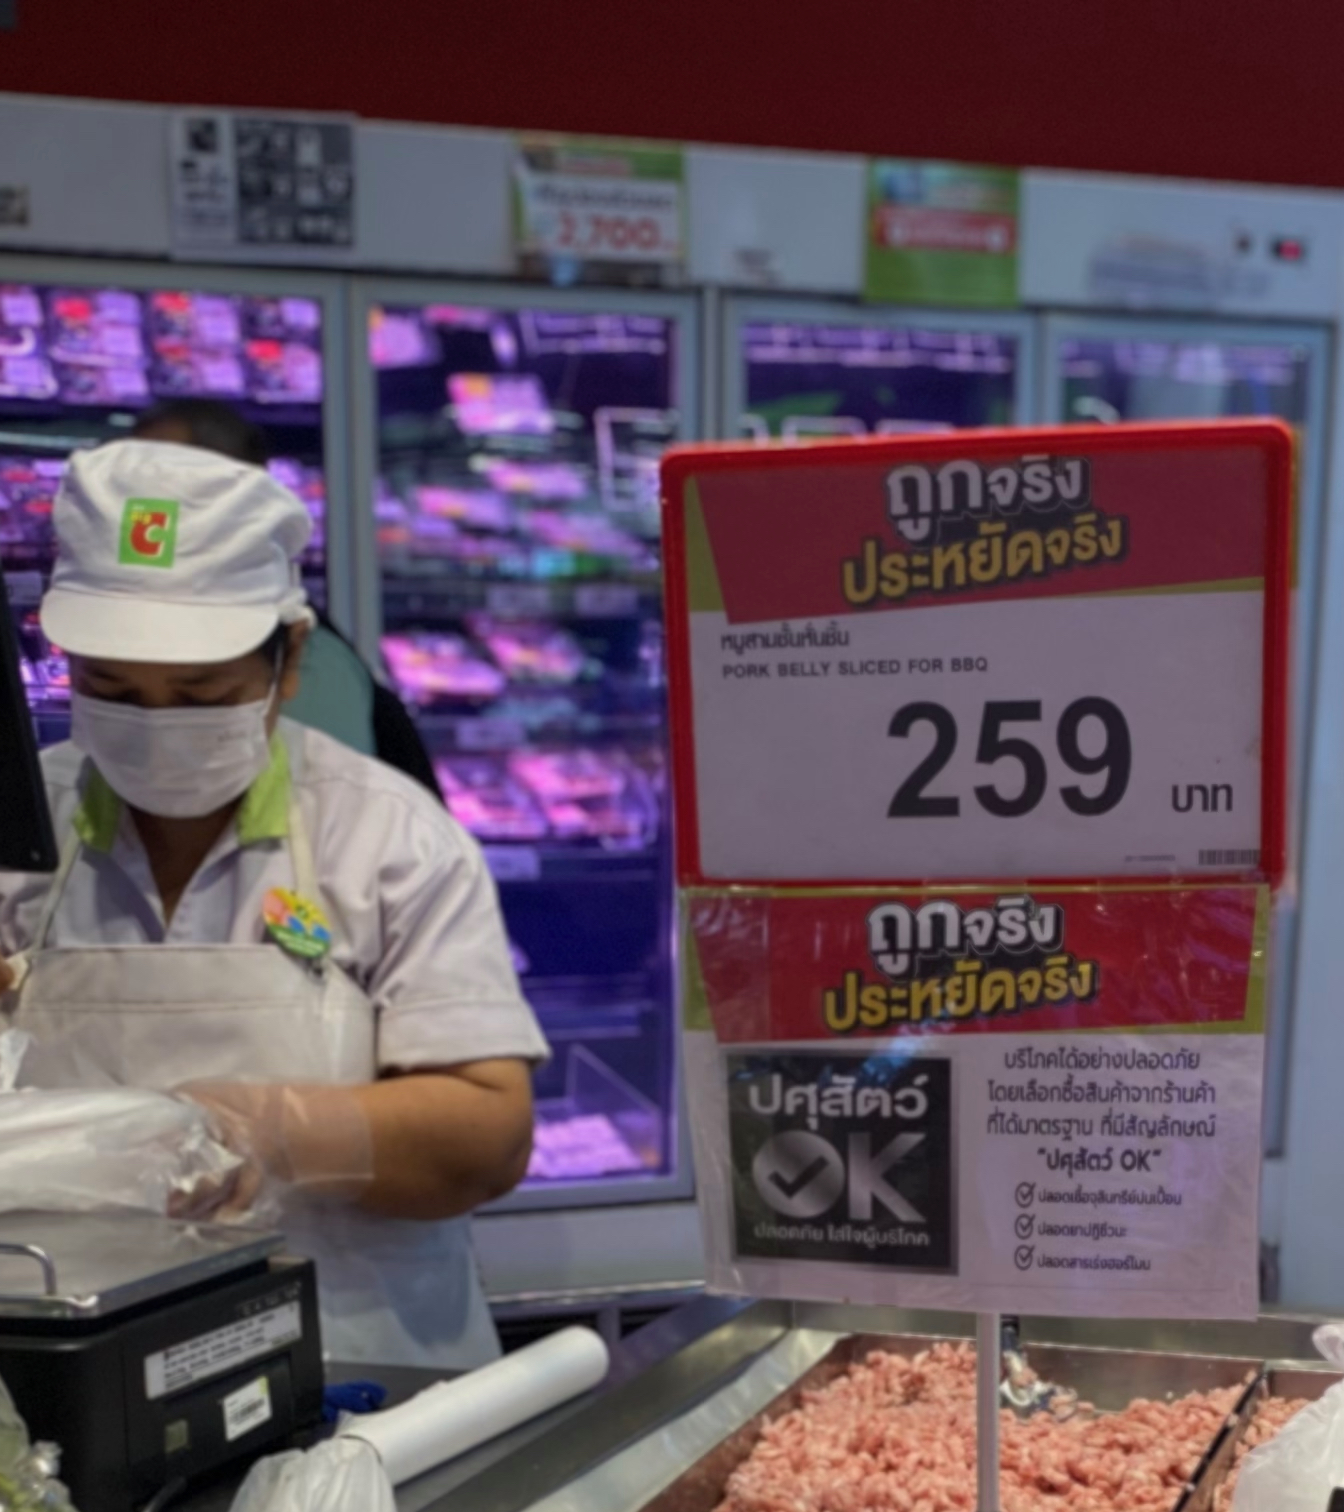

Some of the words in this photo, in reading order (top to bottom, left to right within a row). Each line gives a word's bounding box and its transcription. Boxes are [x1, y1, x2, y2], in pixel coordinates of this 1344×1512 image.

[887, 454, 1081, 541] ถูกจริง
[842, 512, 1123, 604] ประหยัดจริง
[723, 664, 770, 679] PORK
[777, 662, 831, 678] BELLY
[838, 659, 901, 676] SLICED
[908, 657, 944, 673] FOR
[950, 656, 988, 673] BBQ
[886, 695, 1133, 819] 259
[1171, 783, 1233, 813] บาท
[868, 898, 1057, 976] ถูกจริง
[824, 956, 1094, 1031] ประหยัดจริง
[1003, 1045, 1201, 1070] บริโภคได้อย่างปลอดภัย
[749, 1073, 930, 1131] ปศุสัตว์
[987, 1074, 1217, 1103] โดยเลือกซื้อสินค้าจากร้านค้า
[986, 1106, 1094, 1141] ที่ได้มาตรฐาน
[1099, 1107, 1217, 1139] ที่มีสัญลักษณ์
